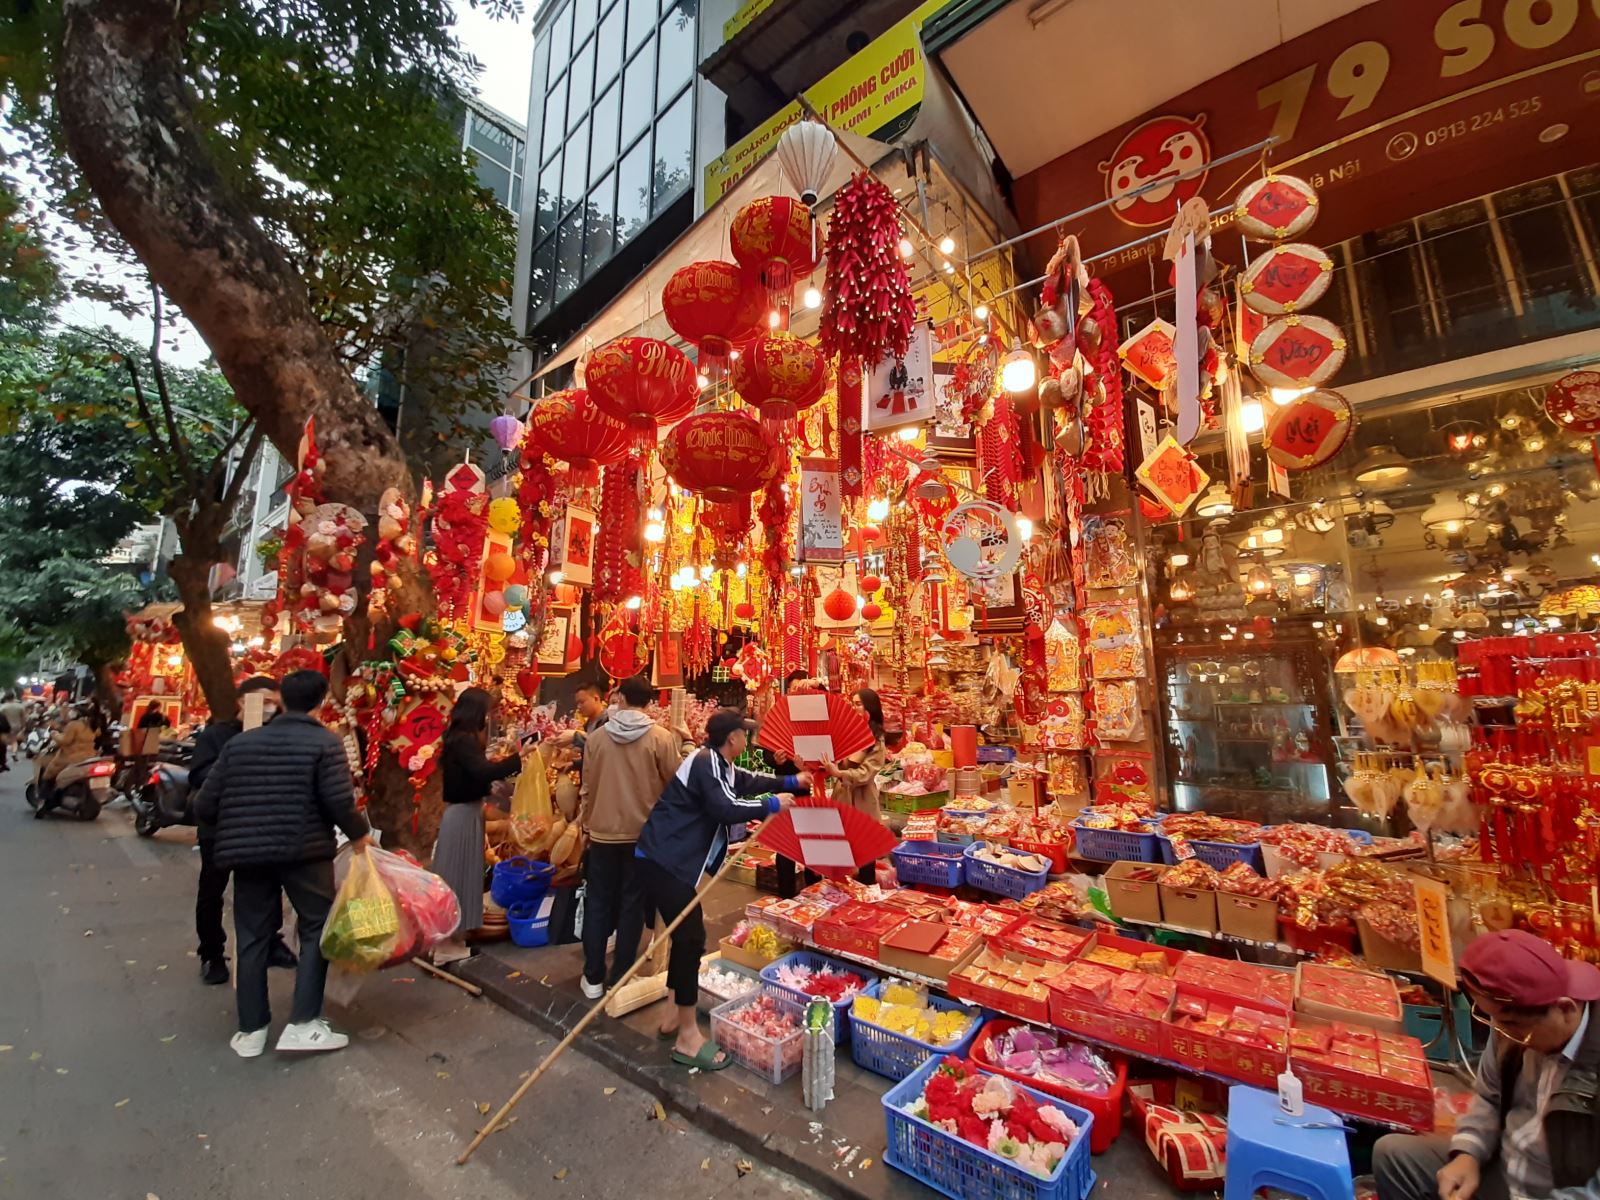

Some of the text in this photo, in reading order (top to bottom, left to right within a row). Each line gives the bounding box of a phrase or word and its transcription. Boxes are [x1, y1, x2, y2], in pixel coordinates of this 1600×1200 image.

[831, 75, 877, 121] PHÔNG
[879, 47, 915, 86] CƯỚI
[883, 76, 918, 105] MIKA
[1256, 0, 1600, 149] 79 SO
[1424, 95, 1543, 147] 0913 224 525
[1101, 257, 1117, 271] 79
[1120, 242, 1157, 264] Hàng
[1328, 158, 1361, 183] Nội
